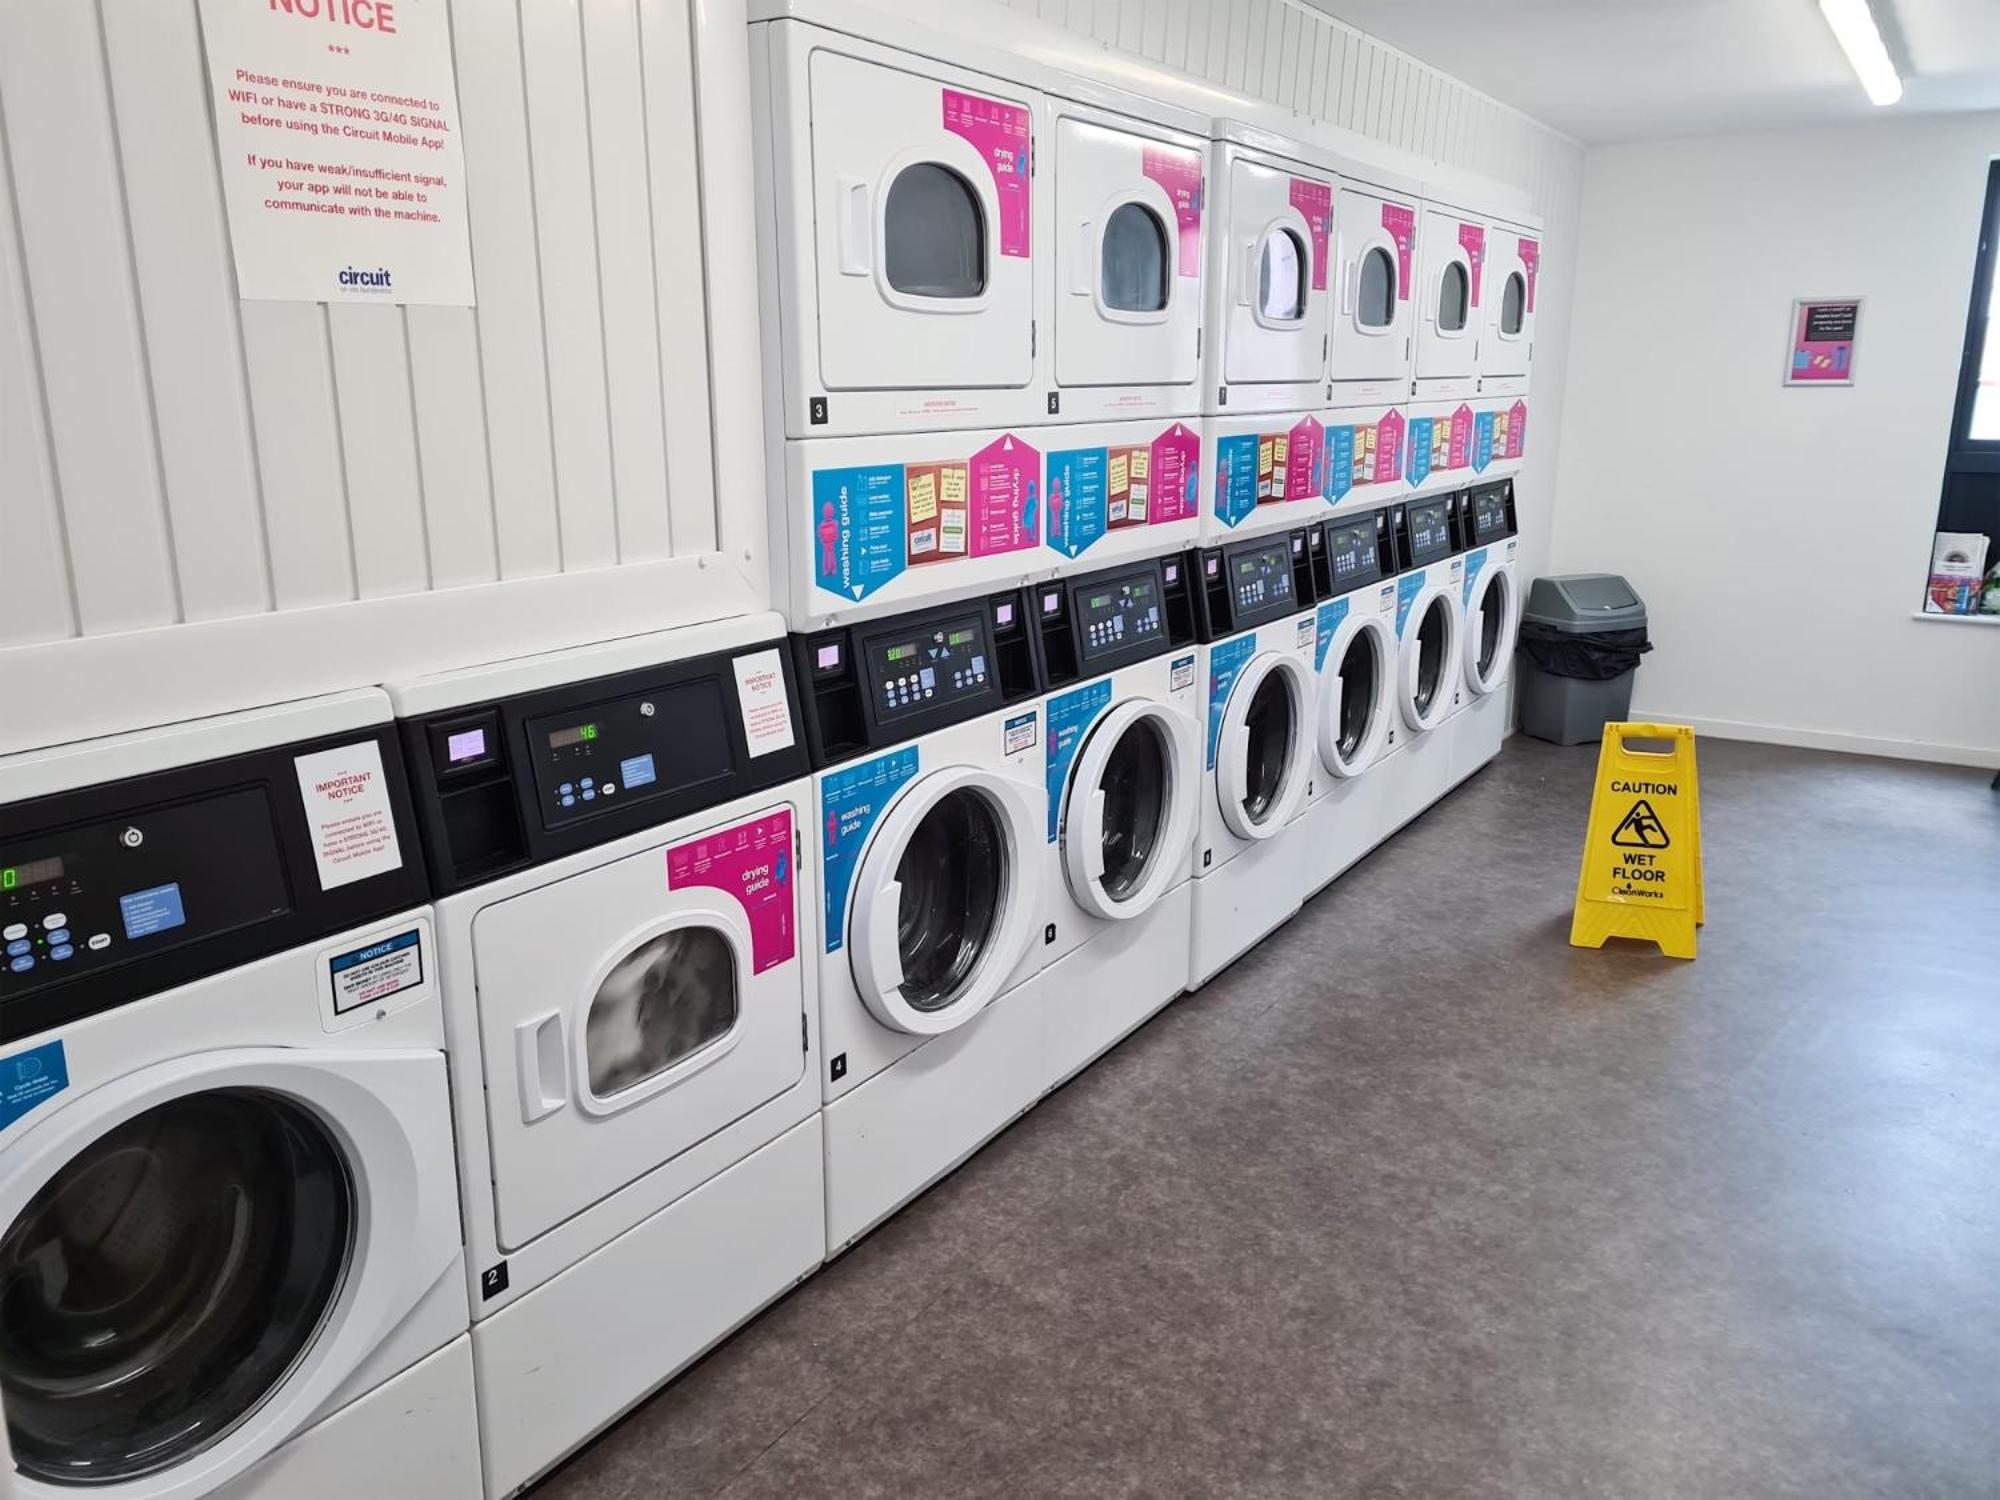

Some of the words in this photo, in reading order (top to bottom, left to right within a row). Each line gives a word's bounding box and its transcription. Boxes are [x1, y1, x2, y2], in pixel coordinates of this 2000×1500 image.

[236, 69, 279, 86] Please
[281, 78, 322, 93] ensure
[325, 85, 346, 97] you
[349, 88, 367, 99] are
[370, 92, 426, 109] connected
[428, 100, 439, 111] to
[228, 88, 257, 104] WIFI
[261, 96, 274, 106] or
[277, 96, 306, 110] have
[310, 103, 317, 112] a
[320, 102, 370, 120] STRONG
[373, 109, 407, 125] 3G/4G
[410, 115, 450, 132] SIGNAL
[241, 112, 282, 127] before
[285, 119, 318, 135] using
[322, 123, 339, 135] the
[343, 125, 379, 140] Circuit
[382, 130, 417, 146] Mobile
[421, 136, 444, 150] App!
[248, 153, 256, 166] If
[259, 157, 282, 169] you
[286, 158, 315, 172] have
[318, 163, 411, 182] weak/insufficient
[414, 173, 447, 187] signal,
[277, 179, 304, 191] your
[307, 183, 329, 195] app
[332, 184, 351, 195] will
[354, 187, 372, 198] not
[375, 187, 388, 198] be
[391, 190, 414, 201] able
[416, 192, 427, 203] to
[264, 199, 345, 214] communicate
[348, 205, 371, 217] with
[374, 206, 391, 218] the
[339, 265, 391, 287] circuit
[815, 404, 823, 418] 3
[838, 485, 850, 525] guide
[839, 530, 850, 589] washing
[580, 723, 597, 740] 46
[315, 771, 372, 793] IMPORTANT
[1611, 781, 1677, 795] CAUTION
[327, 784, 364, 800] NOTICE
[841, 804, 871, 821] washing
[1623, 853, 1656, 866] WET
[741, 864, 769, 882] drying
[1612, 867, 1665, 882] FLOOR
[745, 877, 770, 895] guide
[360, 942, 392, 960] NOTICE
[488, 1269, 498, 1286] 2
